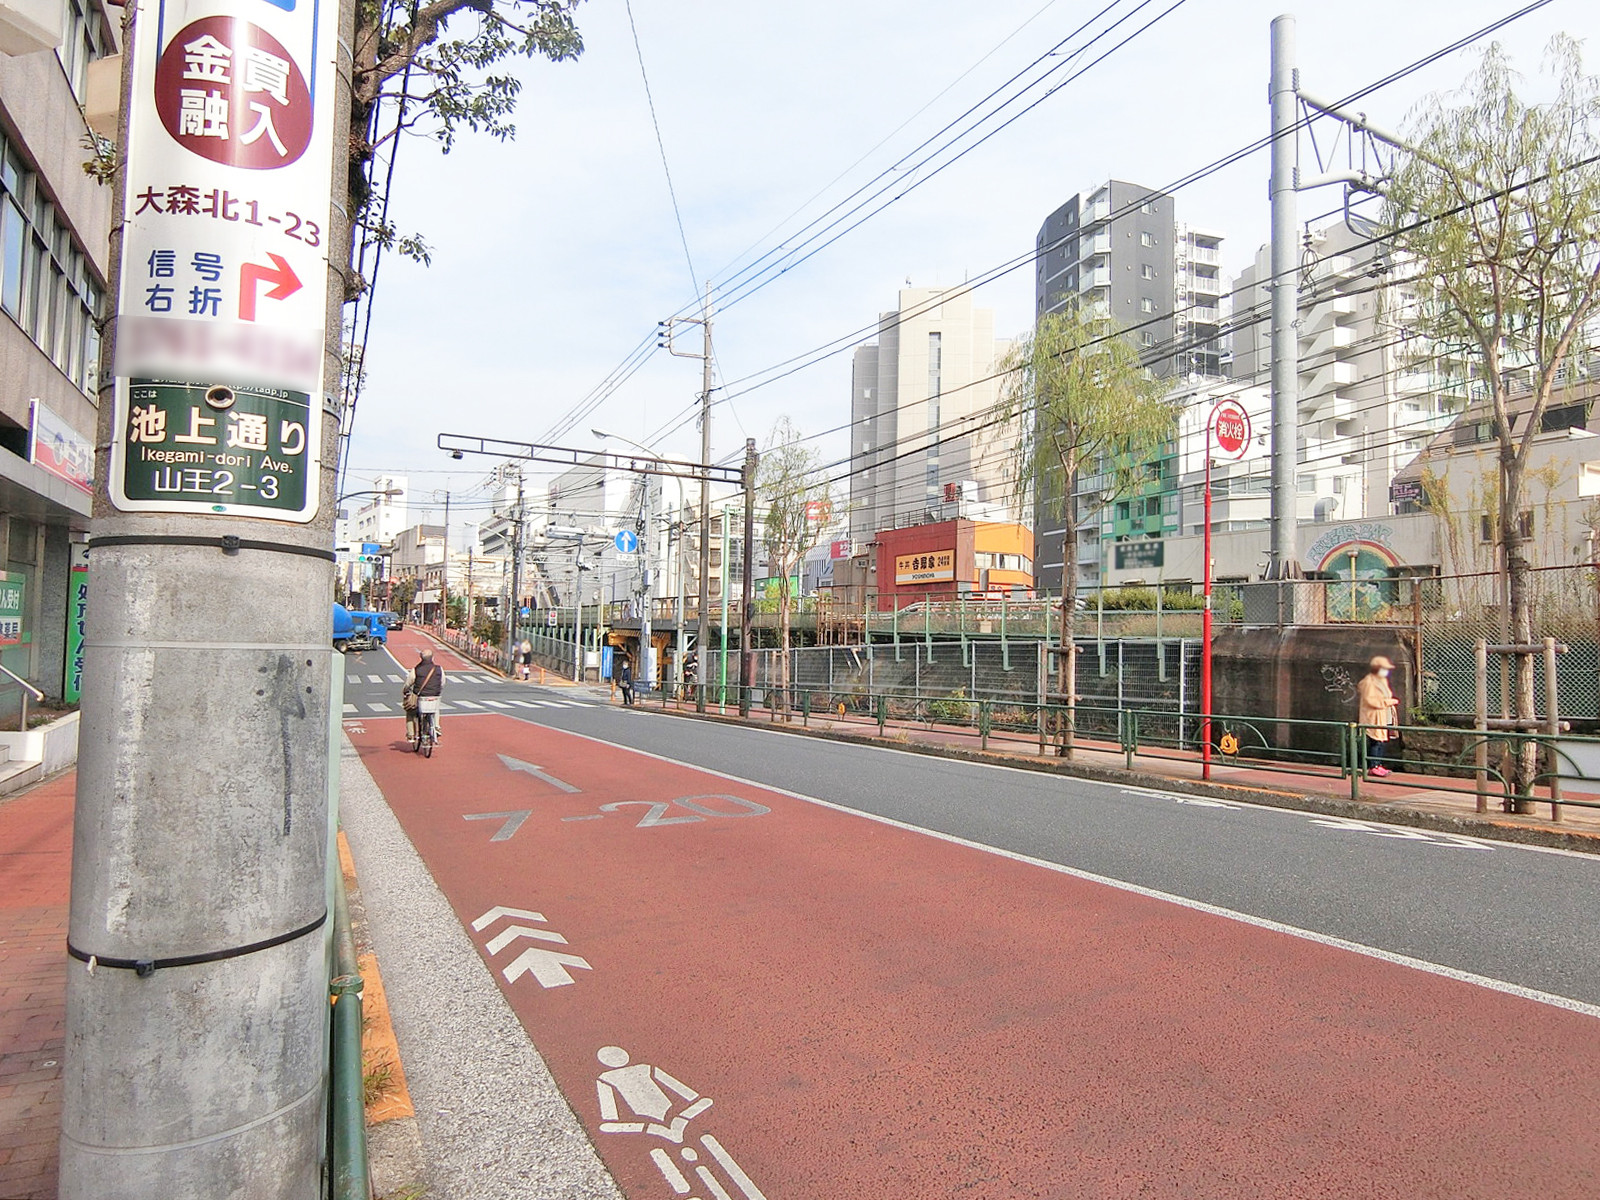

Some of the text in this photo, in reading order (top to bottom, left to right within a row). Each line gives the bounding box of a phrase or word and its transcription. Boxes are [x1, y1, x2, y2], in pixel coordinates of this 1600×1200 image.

[135, 184, 322, 248] 大森北1-23
[147, 249, 224, 282] 信号
[145, 283, 223, 317] 右折
[133, 389, 158, 399] ここは
[130, 404, 306, 456] 池上通り
[1218, 420, 1243, 440] 消火栓
[141, 446, 294, 474] Ikegami-dori Ave.
[154, 466, 280, 500] 山王2-3
[462, 793, 773, 842] 7-20
